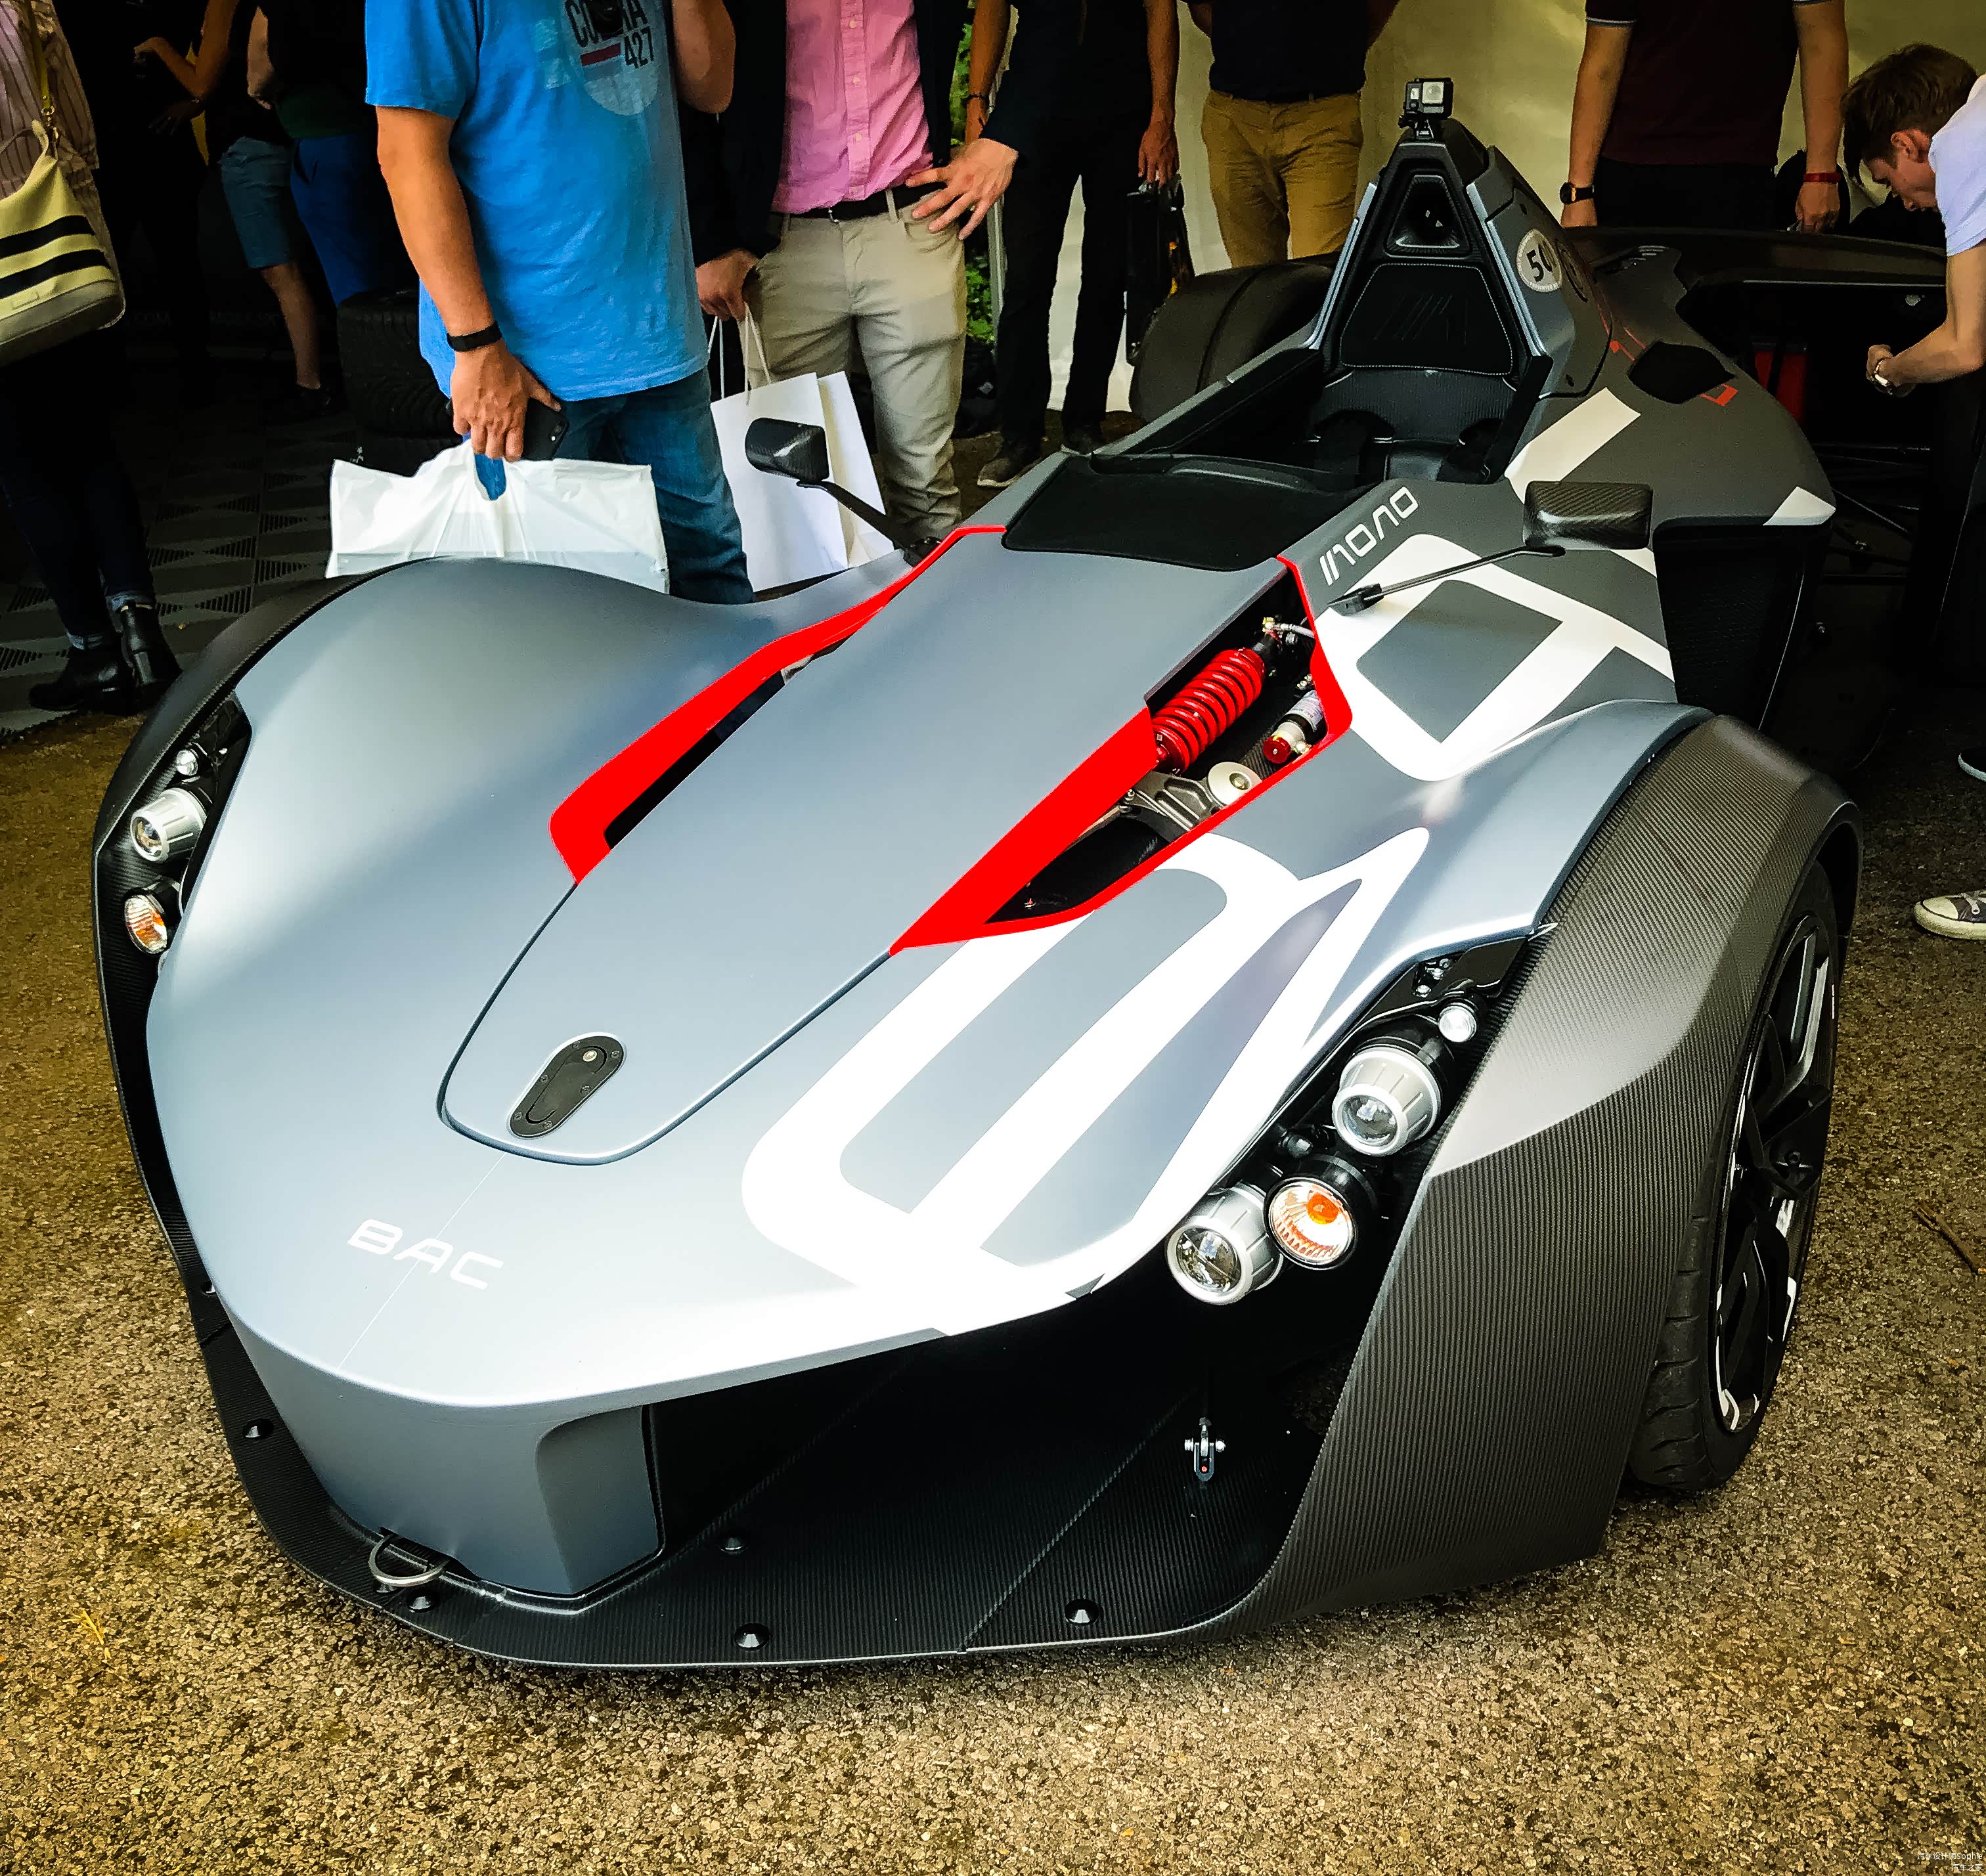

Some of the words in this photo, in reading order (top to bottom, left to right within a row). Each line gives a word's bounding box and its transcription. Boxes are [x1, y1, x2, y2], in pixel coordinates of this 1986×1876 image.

[563, 0, 649, 47] COA
[624, 26, 655, 69] 427
[347, 1219, 504, 1290] BAC
